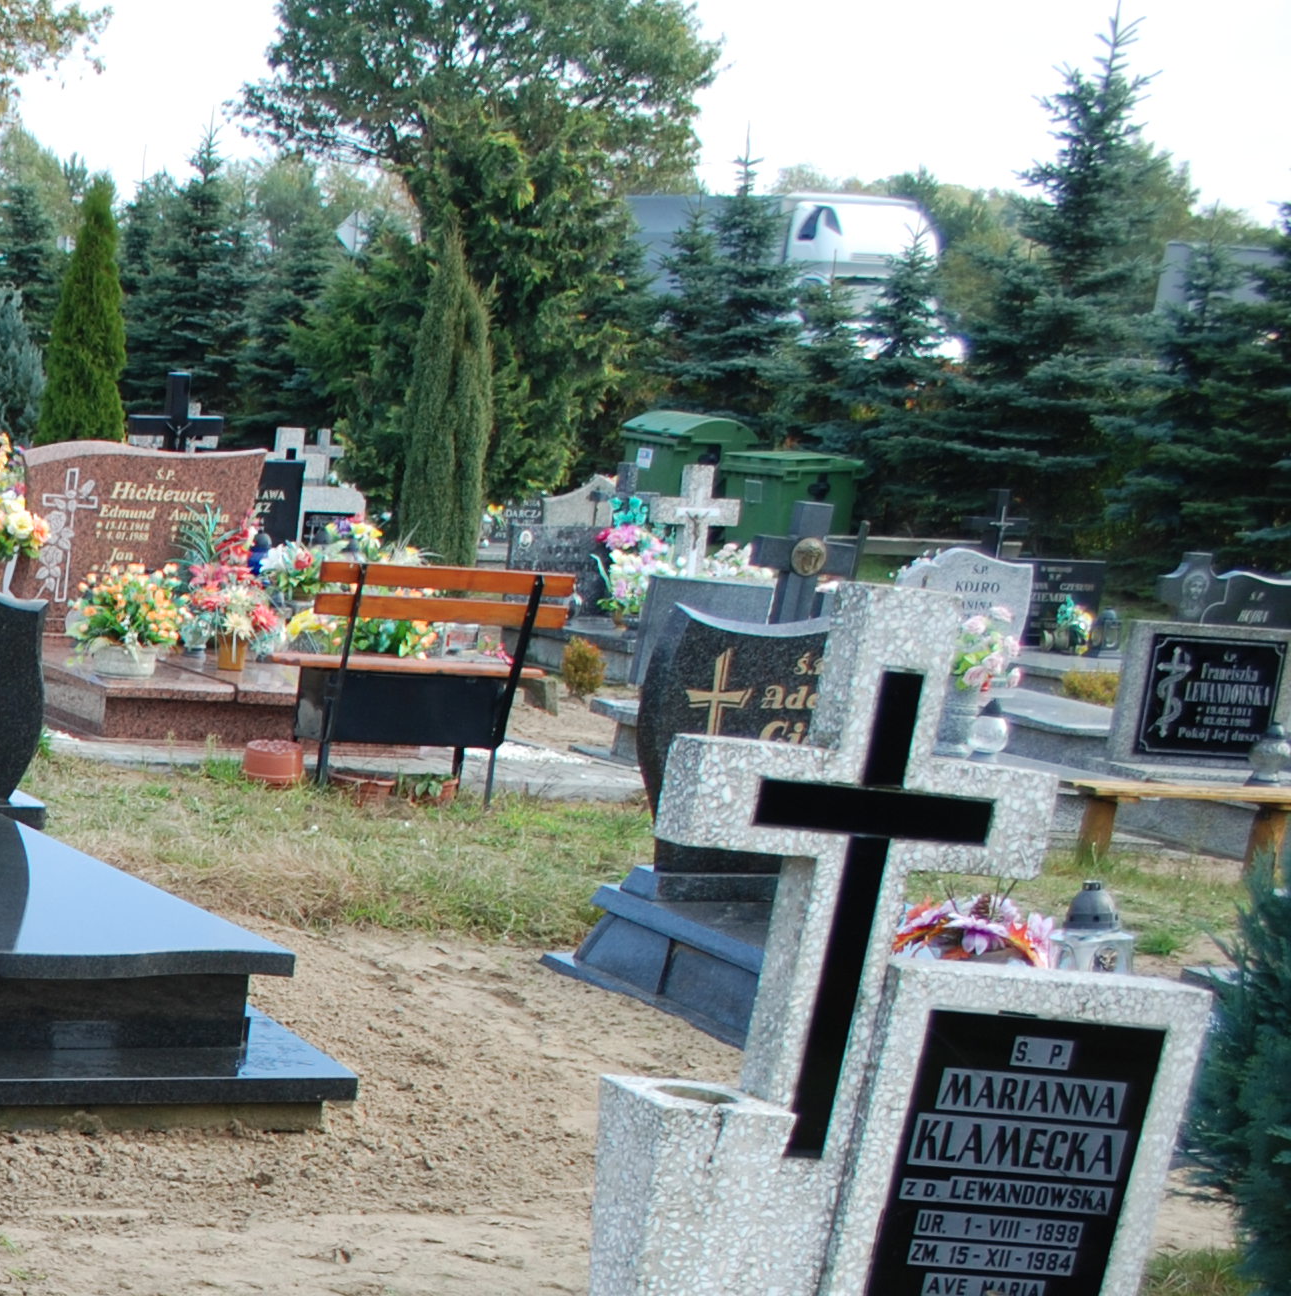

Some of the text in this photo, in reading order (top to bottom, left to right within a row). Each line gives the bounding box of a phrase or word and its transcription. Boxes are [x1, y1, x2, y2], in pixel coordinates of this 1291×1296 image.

[109, 480, 217, 505] Hickiewicz
[99, 503, 158, 521] Edmund
[109, 546, 135, 564] Jan
[940, 1073, 1117, 1120] MARIANNA
[912, 1118, 1114, 1176] KLAMECKA
[949, 1178, 1108, 1213] LEWANDOWSKA
[918, 1213, 948, 1235] UR.
[910, 1243, 940, 1265] ZM.
[926, 1276, 969, 1296] AVE
